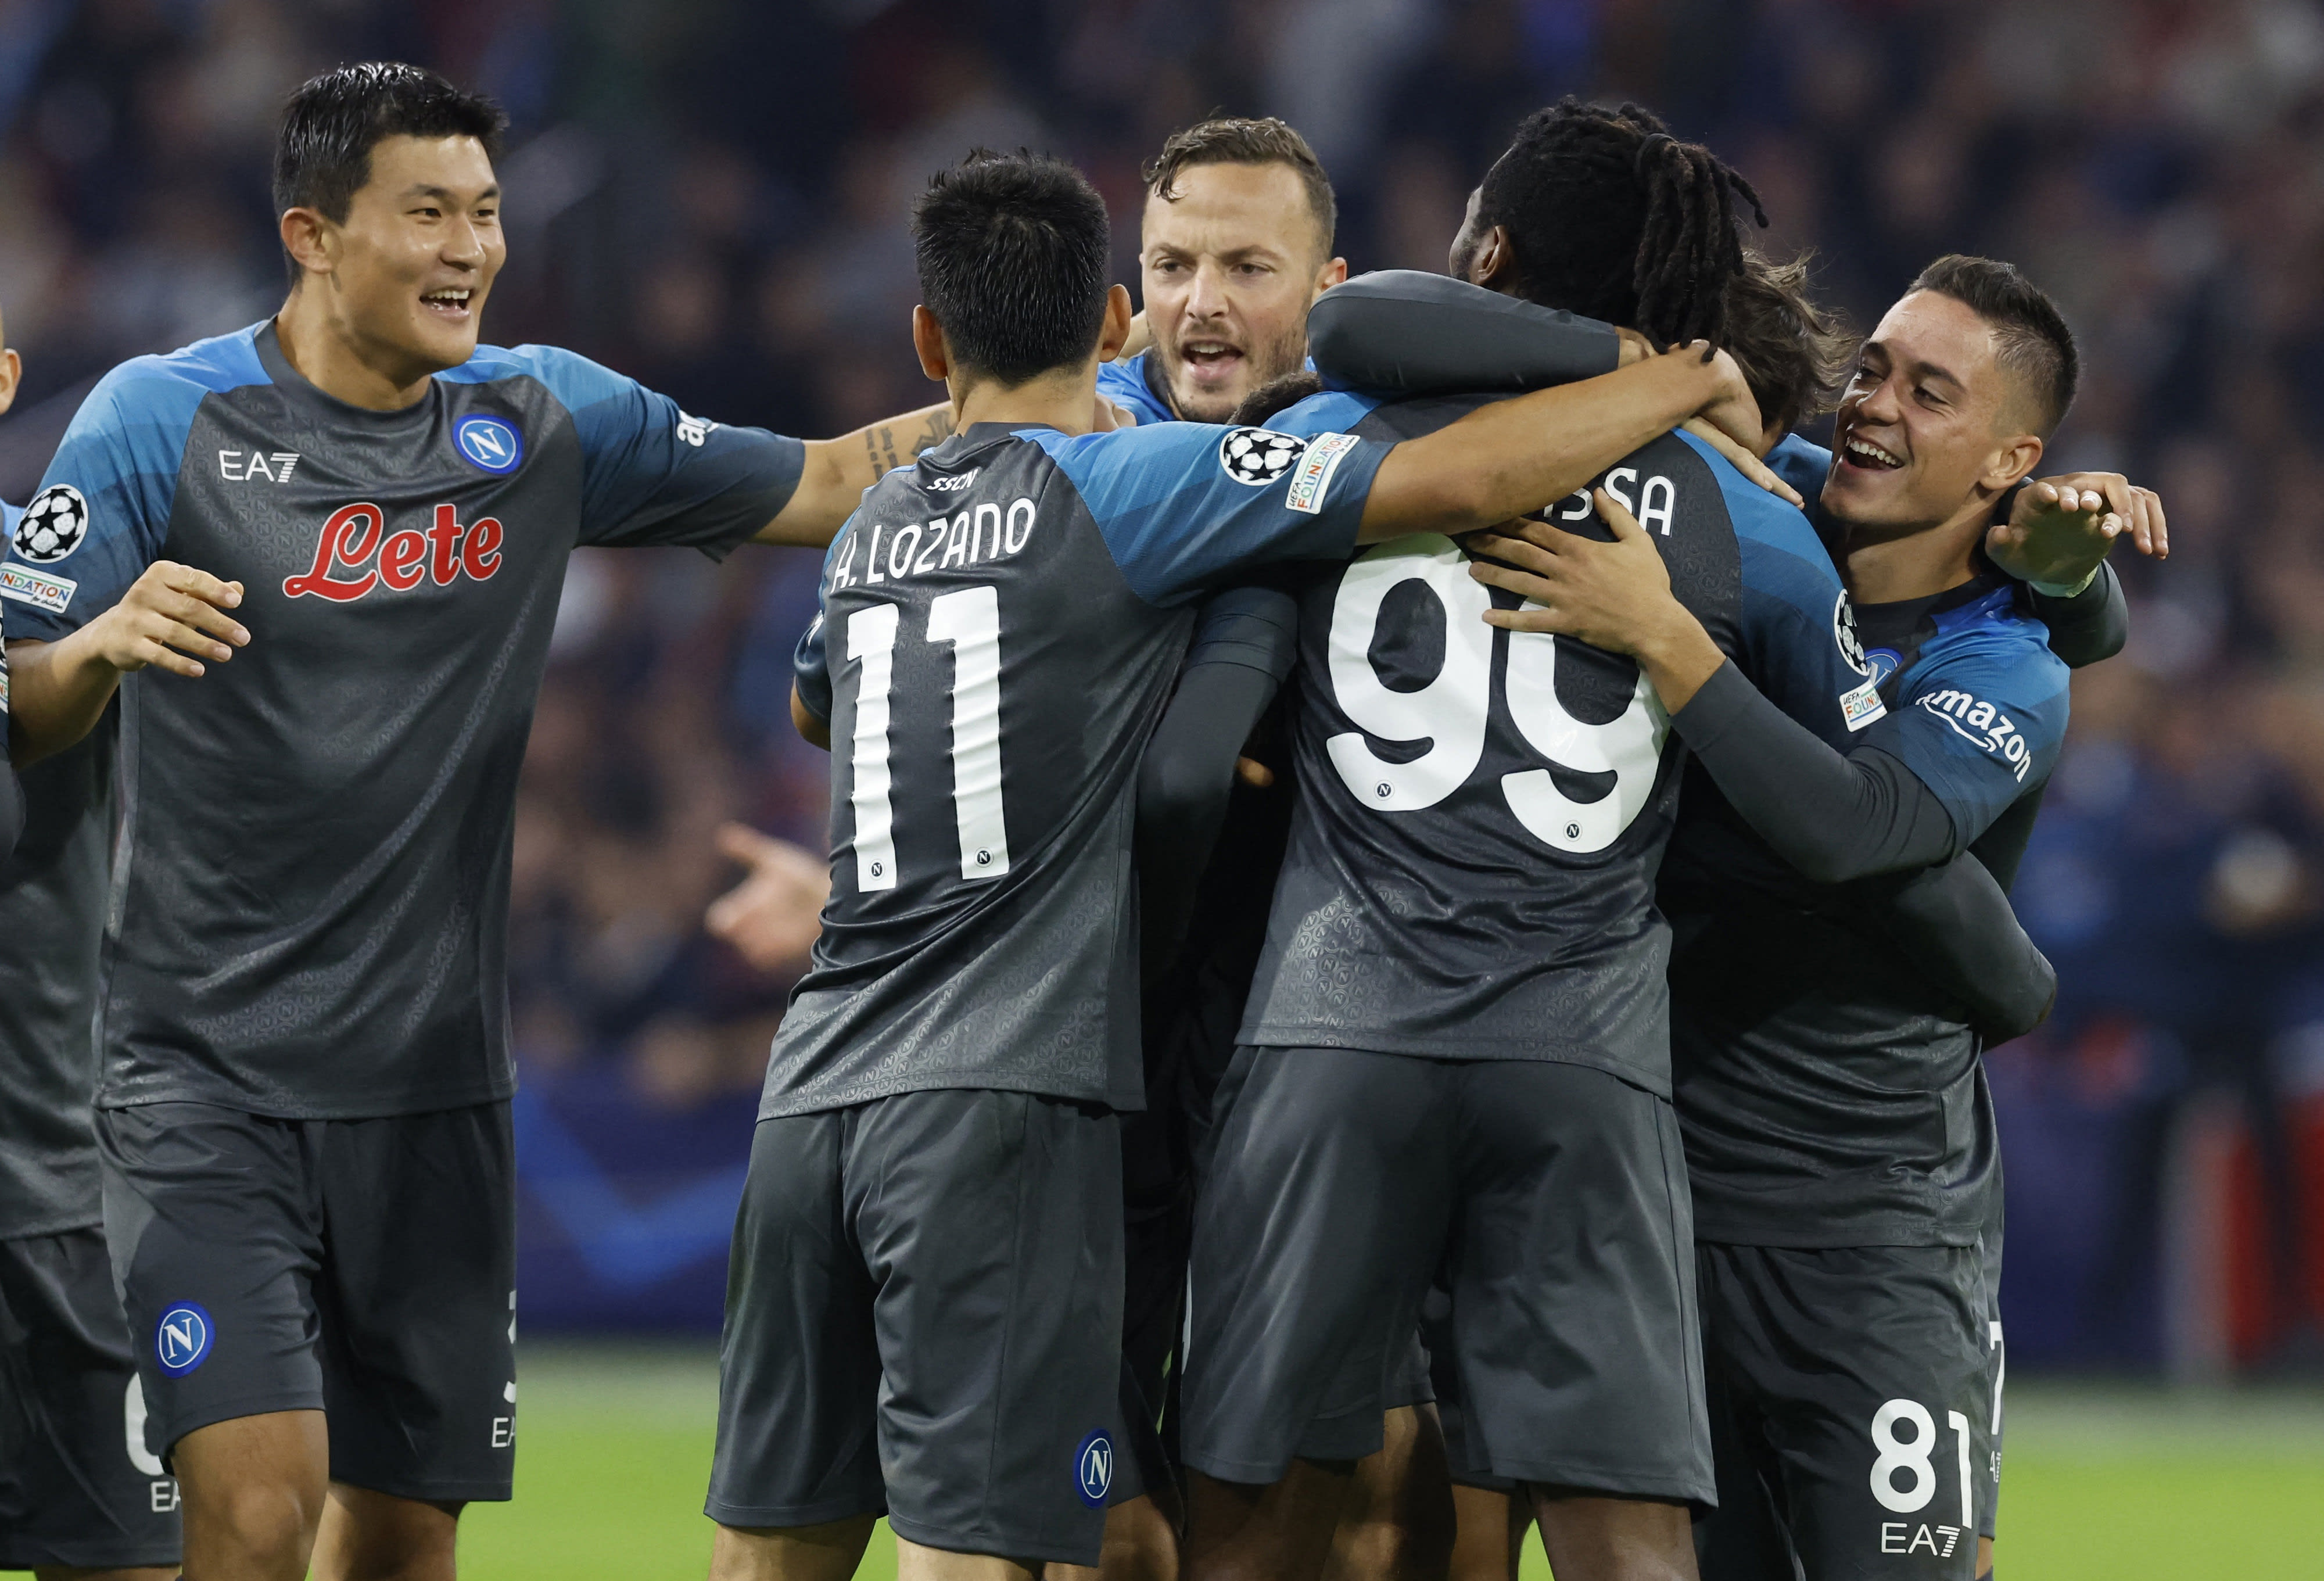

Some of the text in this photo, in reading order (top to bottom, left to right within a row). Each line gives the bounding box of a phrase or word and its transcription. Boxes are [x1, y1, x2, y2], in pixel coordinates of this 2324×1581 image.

[467, 428, 506, 460] N
[218, 449, 300, 483] EA7
[926, 469, 978, 491] SSCN
[1288, 481, 1301, 507] UEFA
[282, 503, 503, 602] Lete
[830, 497, 1036, 594] H. LOZANO
[1326, 533, 1671, 854] 99
[847, 585, 1010, 893] 11
[1915, 690, 2031, 783] amazon
[164, 1317, 193, 1359] N
[1087, 1450, 1109, 1486] N
[1870, 1398, 1972, 1530] 81
[1881, 1522, 1960, 1558] EA7
